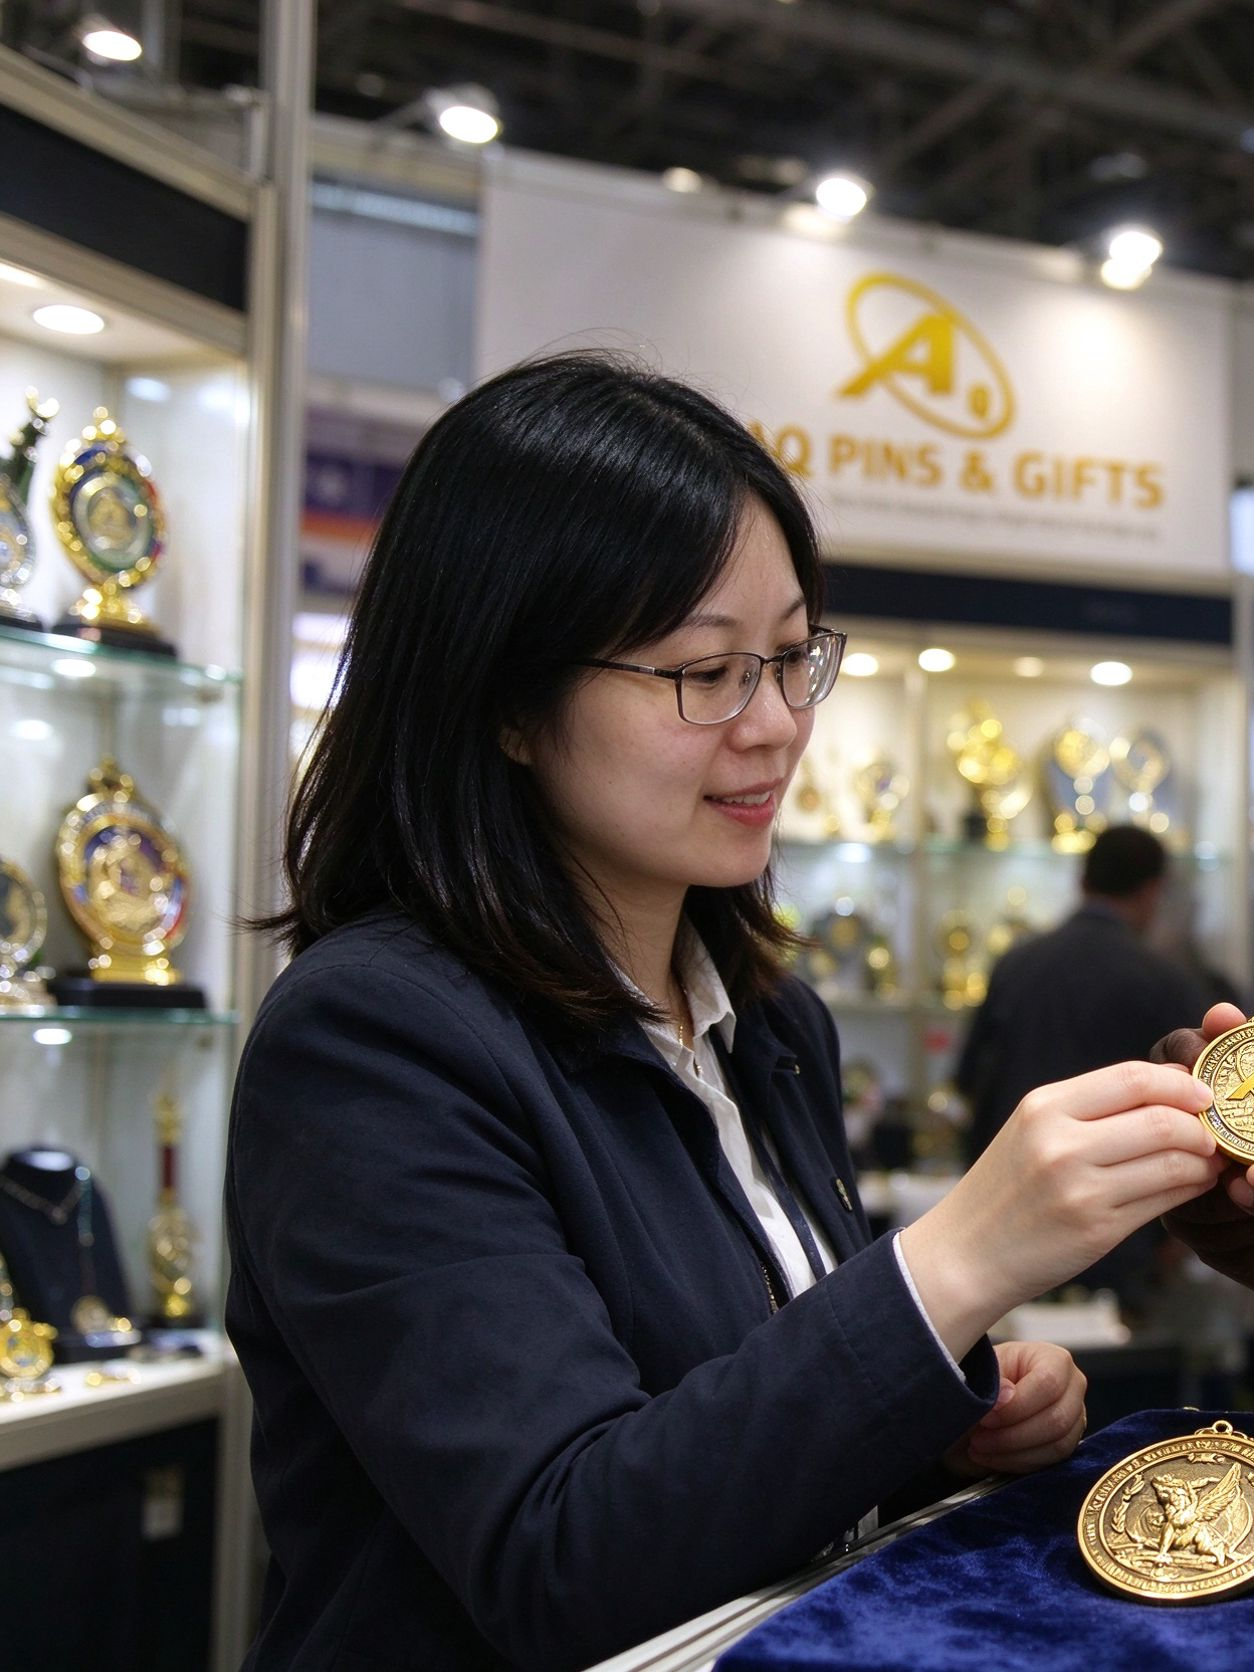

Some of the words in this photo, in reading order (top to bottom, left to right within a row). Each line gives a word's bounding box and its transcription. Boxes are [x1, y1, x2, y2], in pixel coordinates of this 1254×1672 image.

[838, 312, 956, 398] A
[829, 434, 943, 489] PINS
[959, 449, 994, 492] &
[1013, 451, 1165, 509] GIFTS
